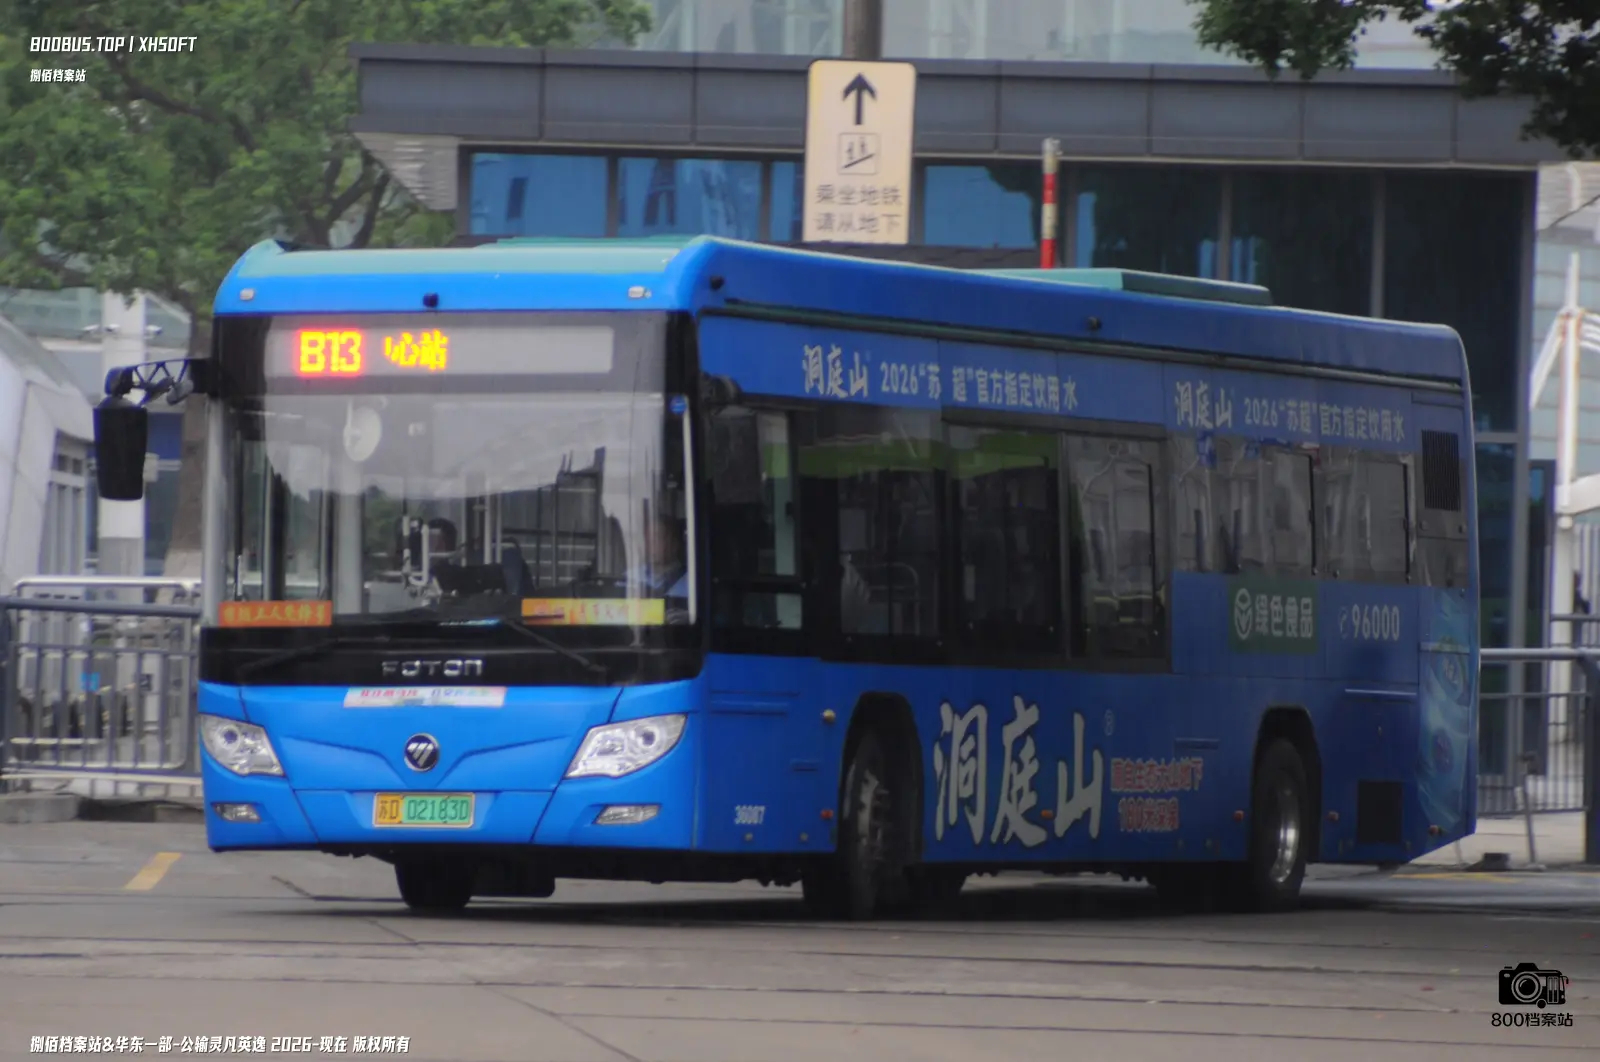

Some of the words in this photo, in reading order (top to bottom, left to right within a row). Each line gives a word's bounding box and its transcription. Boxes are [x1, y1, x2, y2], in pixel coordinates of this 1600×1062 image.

[299, 330, 363, 373] B13
[384, 329, 449, 370] 心站
[802, 344, 869, 398] 洞庭山
[1175, 380, 1232, 429] 洞庭山
[1255, 594, 1314, 640] 绿色食品
[1352, 603, 1400, 641] 96000
[382, 659, 483, 677] FOTON
[934, 695, 1103, 848] 洞庭山
